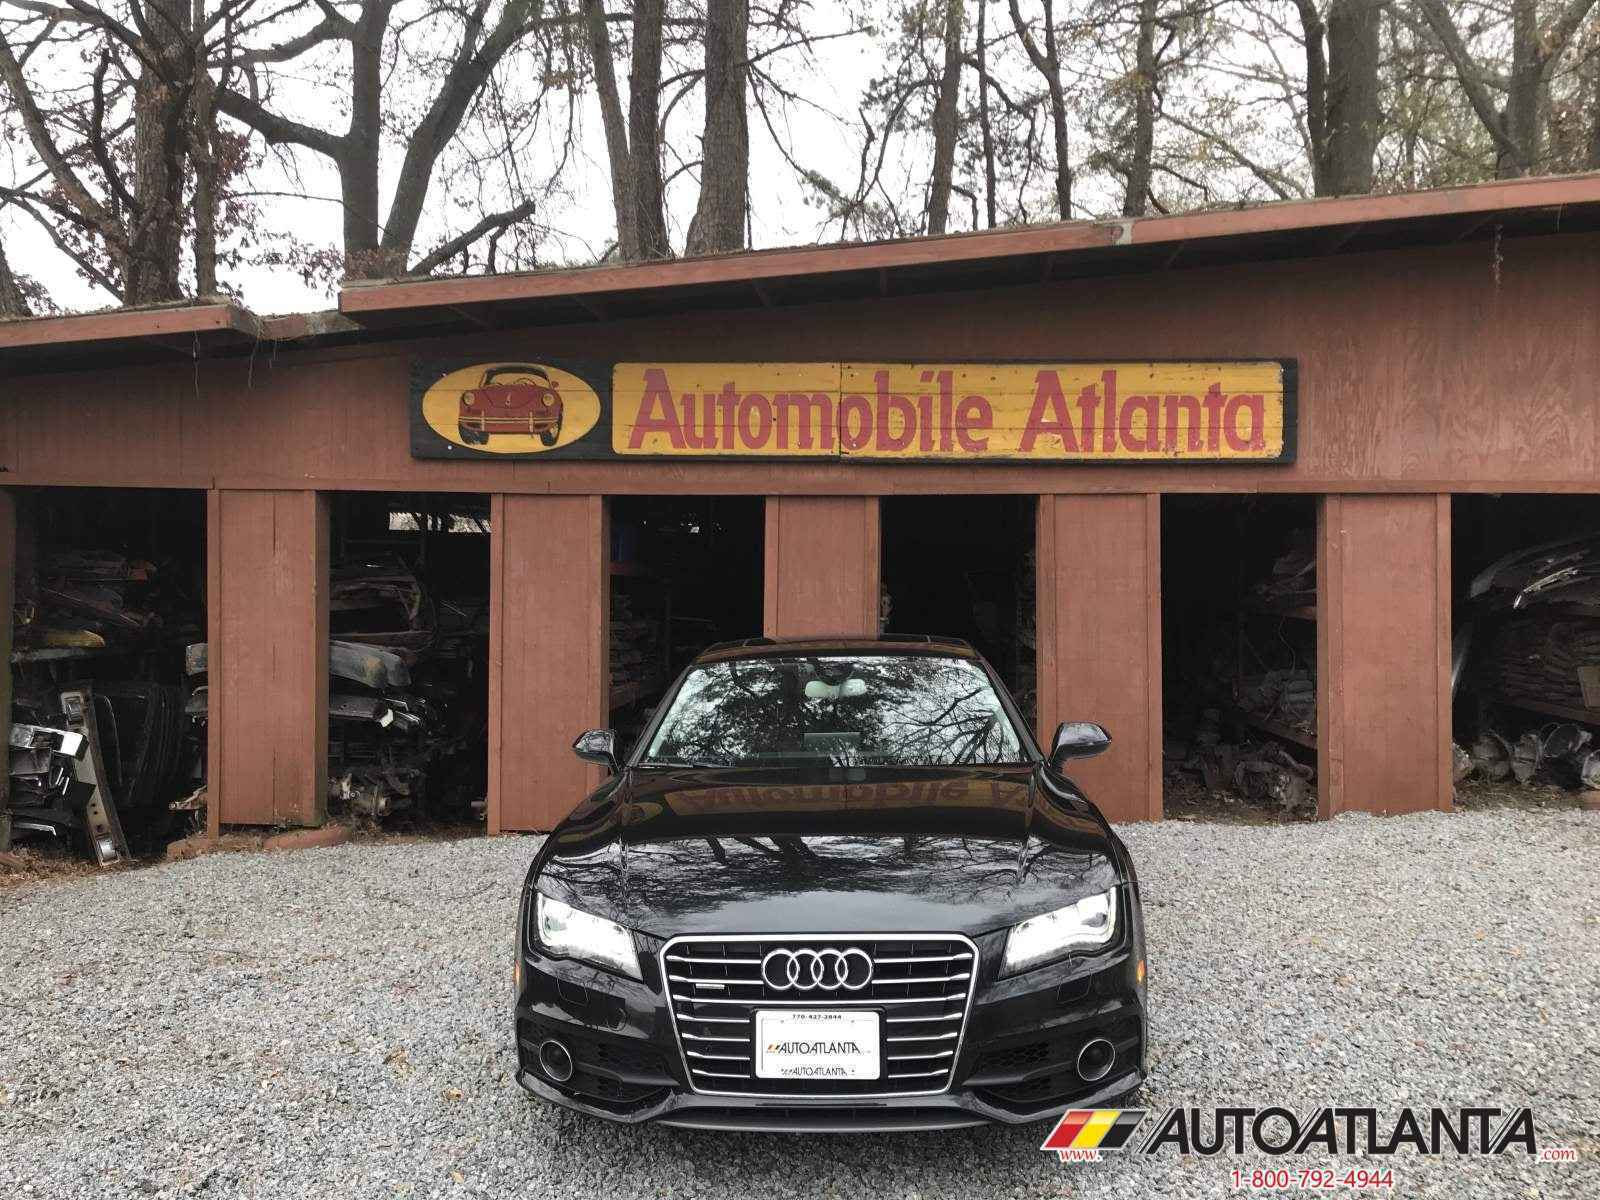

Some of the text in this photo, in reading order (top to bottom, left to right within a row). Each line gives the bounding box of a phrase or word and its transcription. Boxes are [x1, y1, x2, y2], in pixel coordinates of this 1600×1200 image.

[628, 368, 1267, 453] Automobile Atlanta
[779, 1041, 860, 1054] AUTOATLANTA
